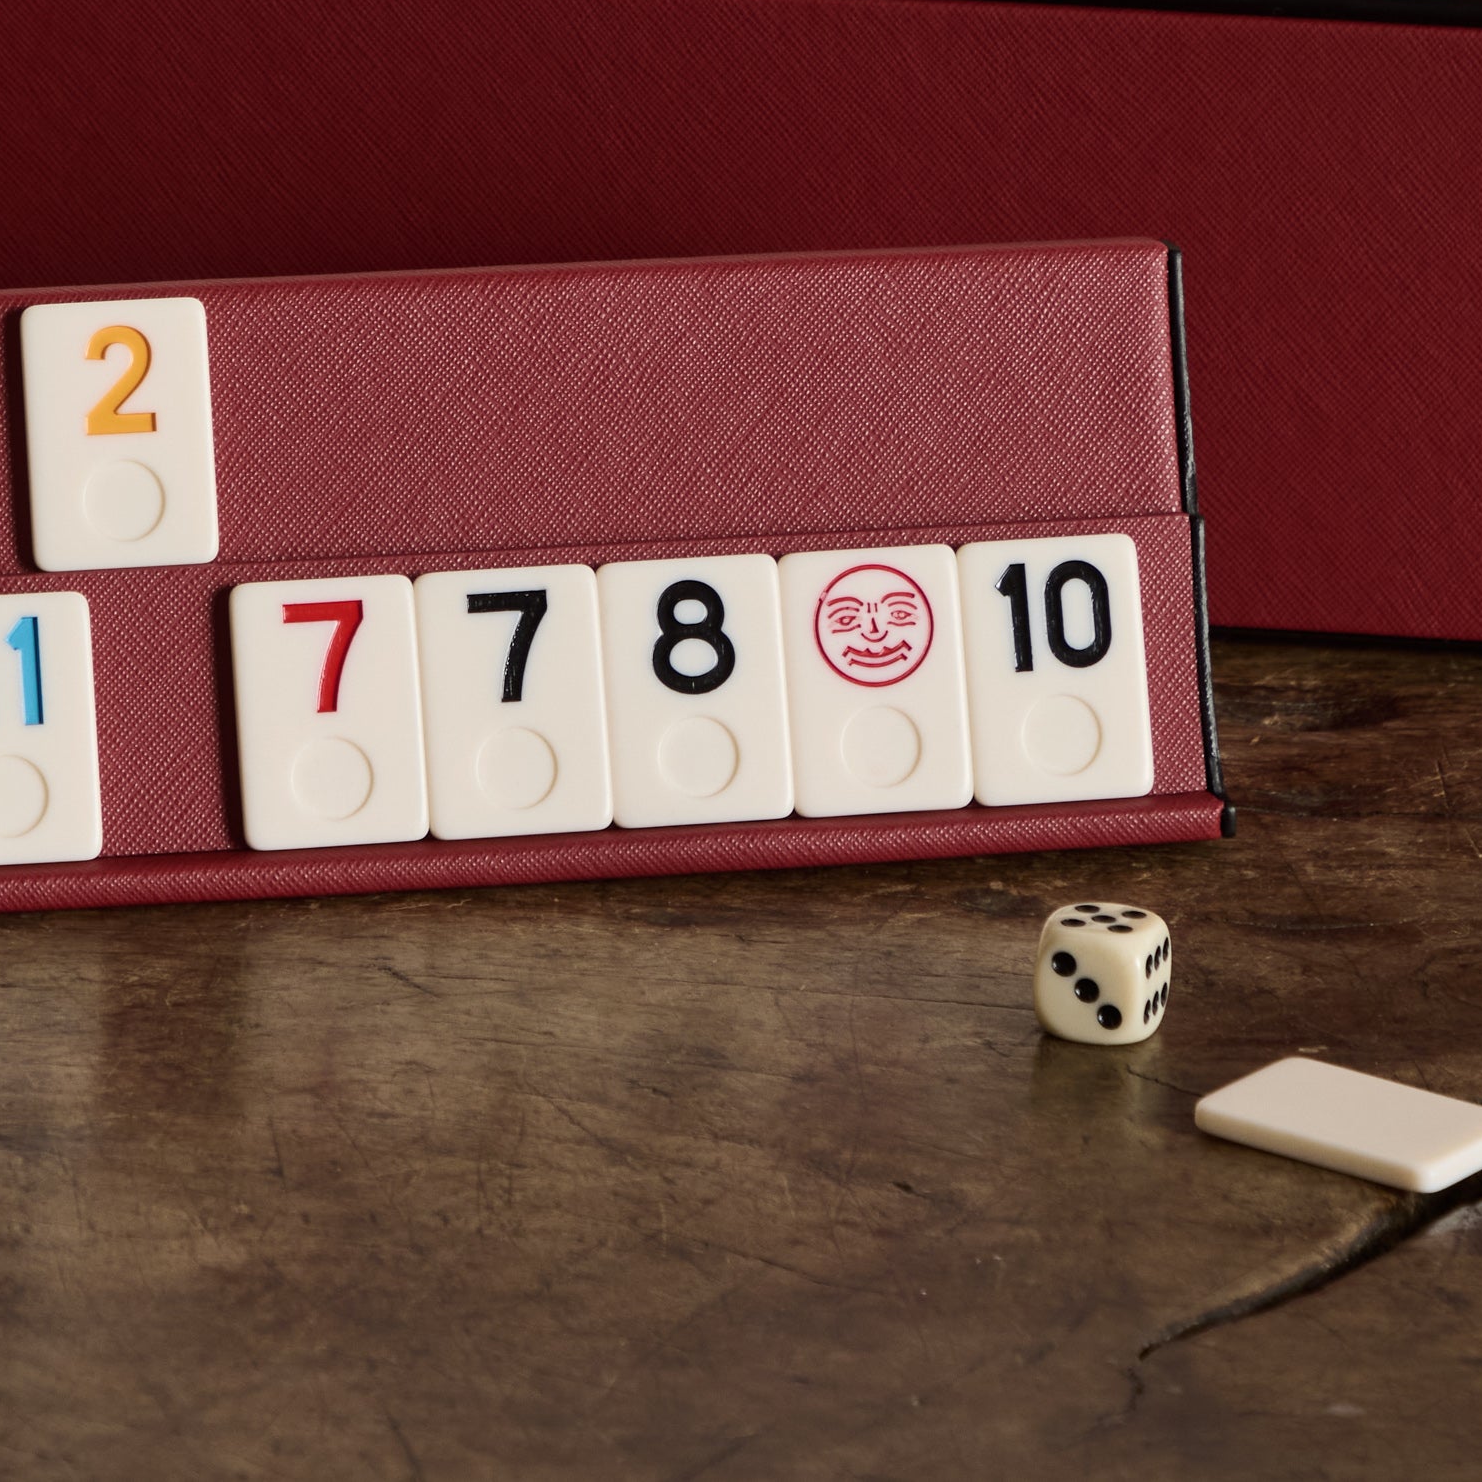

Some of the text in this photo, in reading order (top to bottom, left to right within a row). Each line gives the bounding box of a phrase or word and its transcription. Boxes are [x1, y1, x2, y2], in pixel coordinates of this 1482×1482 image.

[86, 325, 159, 436] 2
[281, 599, 364, 714] 7
[466, 588, 549, 704] 7
[651, 579, 736, 696] 8
[994, 559, 1113, 673] 10
